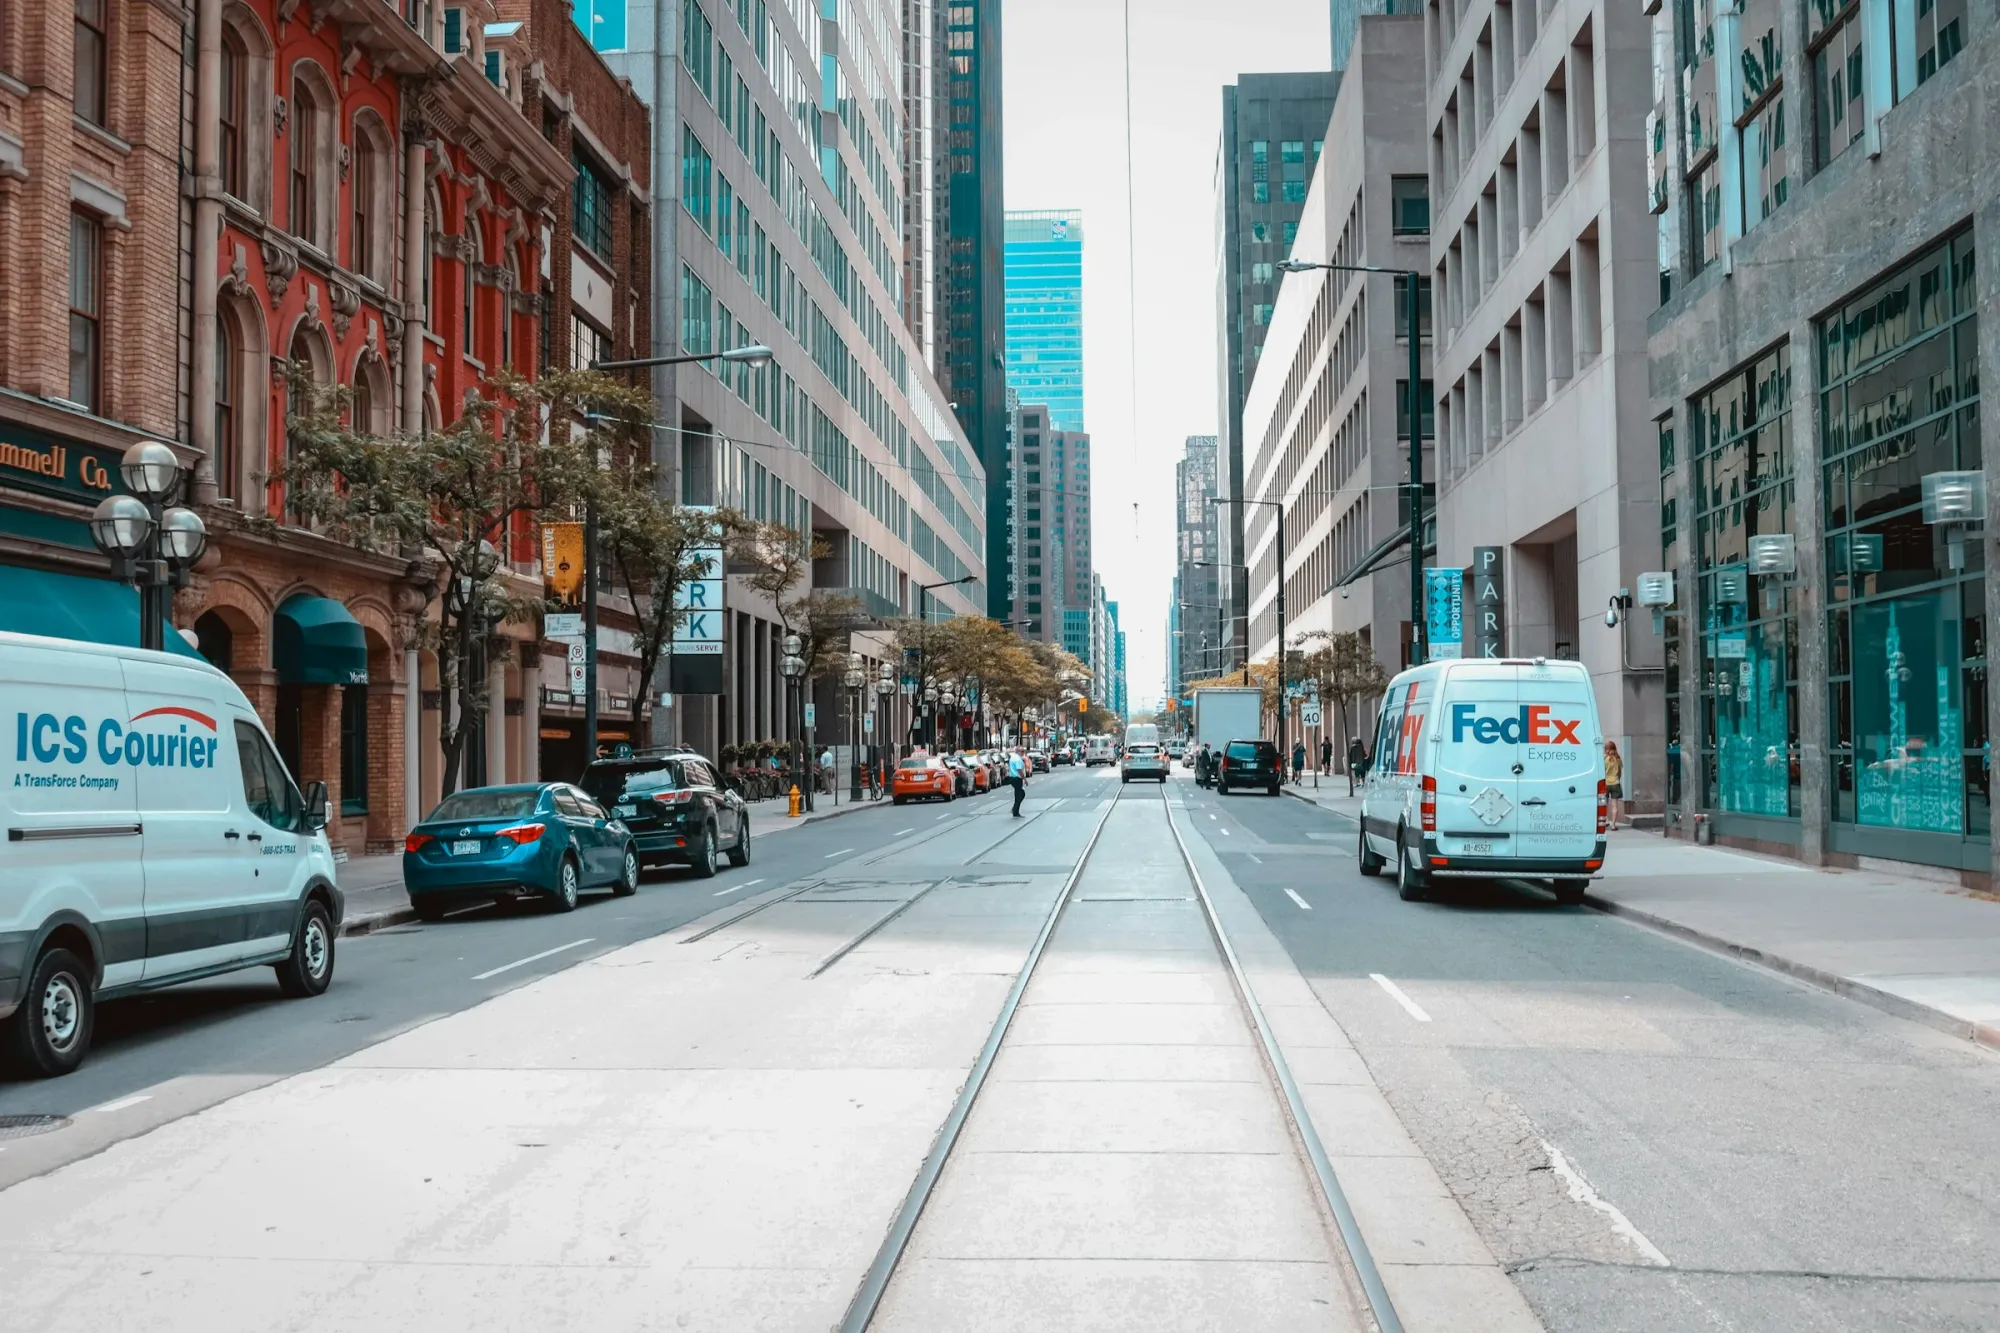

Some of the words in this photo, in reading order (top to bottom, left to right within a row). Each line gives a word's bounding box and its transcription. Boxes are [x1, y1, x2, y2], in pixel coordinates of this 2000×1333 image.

[80, 456, 112, 490] Co.
[545, 528, 555, 577] ACHIEVE
[1451, 572, 1461, 639] OPPORTUNITY
[1482, 552, 1498, 658] PARK
[1304, 713, 1319, 723] 40
[1452, 704, 1581, 744] FedEx
[16, 712, 87, 764] ICS
[97, 718, 218, 769] Courier
[1528, 748, 1577, 761] Express
[14, 774, 21, 787] A
[24, 773, 78, 788] TransForce
[80, 774, 119, 791] Company
